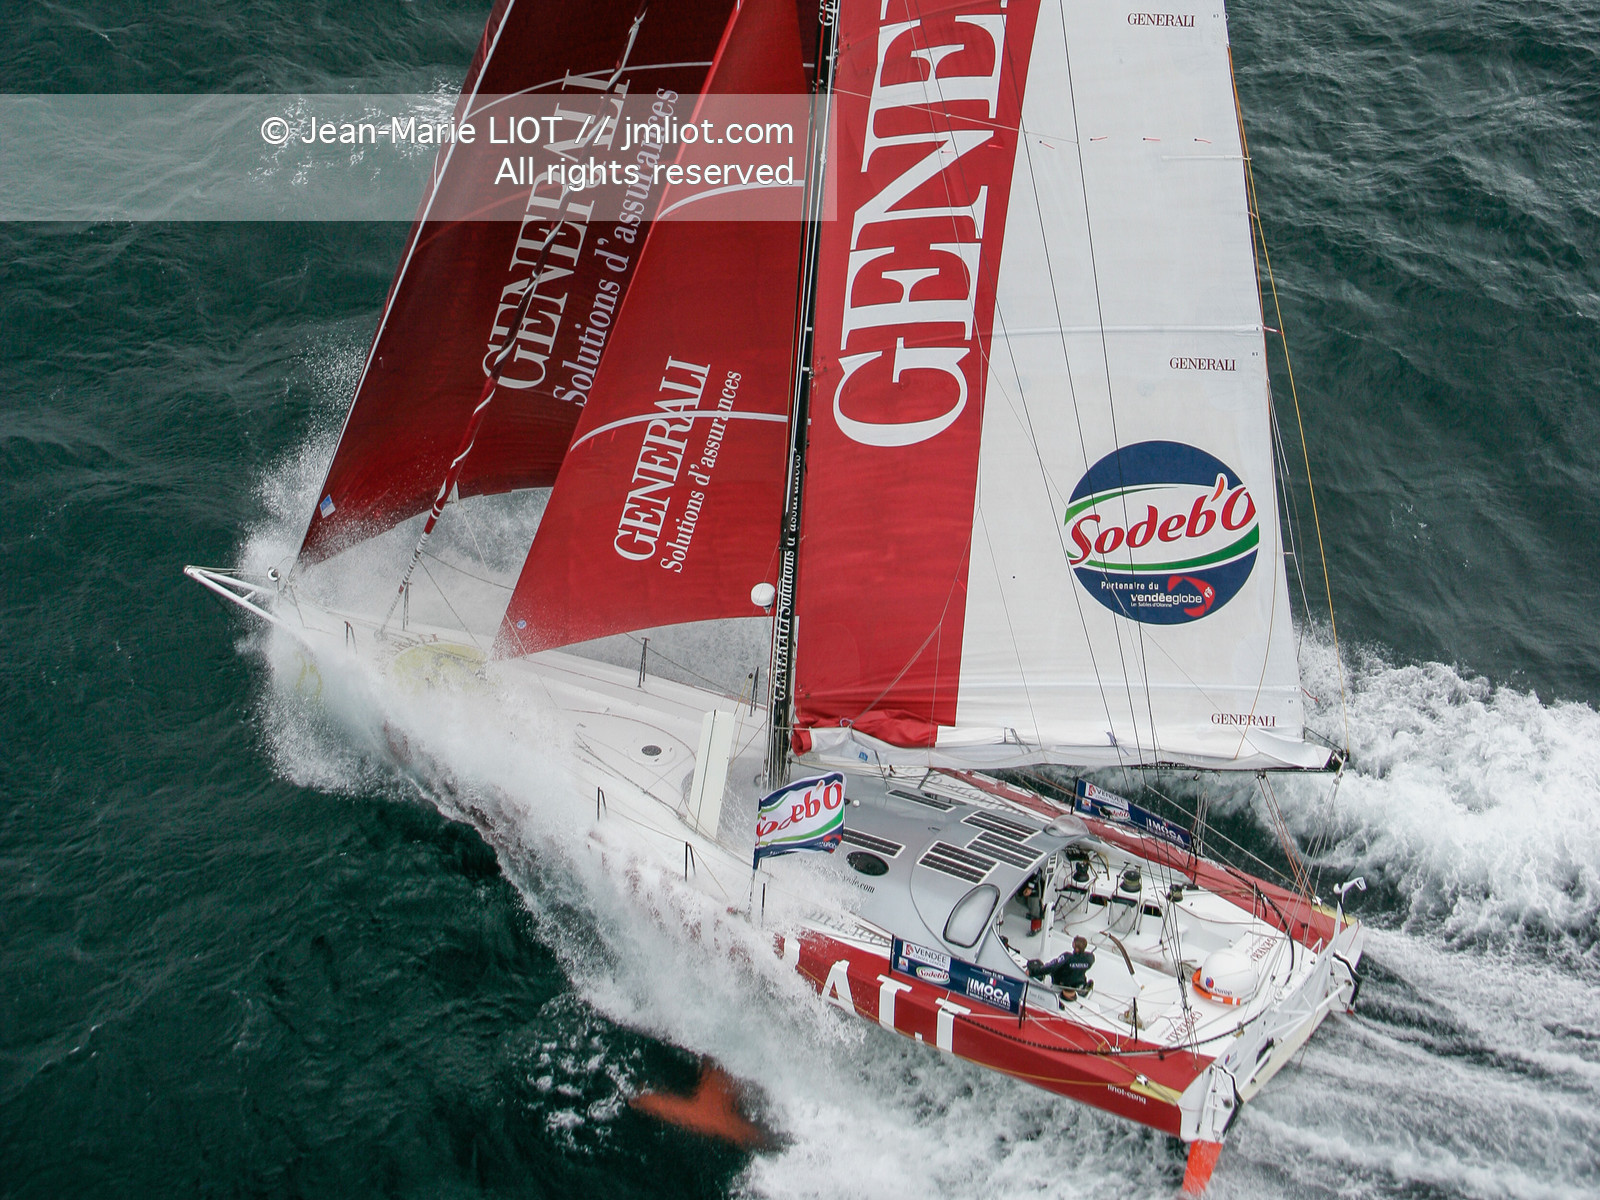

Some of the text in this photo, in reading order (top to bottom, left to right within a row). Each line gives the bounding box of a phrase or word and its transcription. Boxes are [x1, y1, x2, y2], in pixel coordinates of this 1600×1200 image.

[1127, 12, 1196, 28] GENERALI
[553, 277, 621, 408] Solutions
[1169, 357, 1237, 372] GENERALI
[613, 355, 711, 561] GENERALI
[660, 490, 705, 574] Solutions
[1069, 476, 1257, 566] Sodeb'O
[1148, 581, 1159, 590] du
[1210, 713, 1276, 727] GENERALI
[969, 977, 1011, 1004] IMOCA
